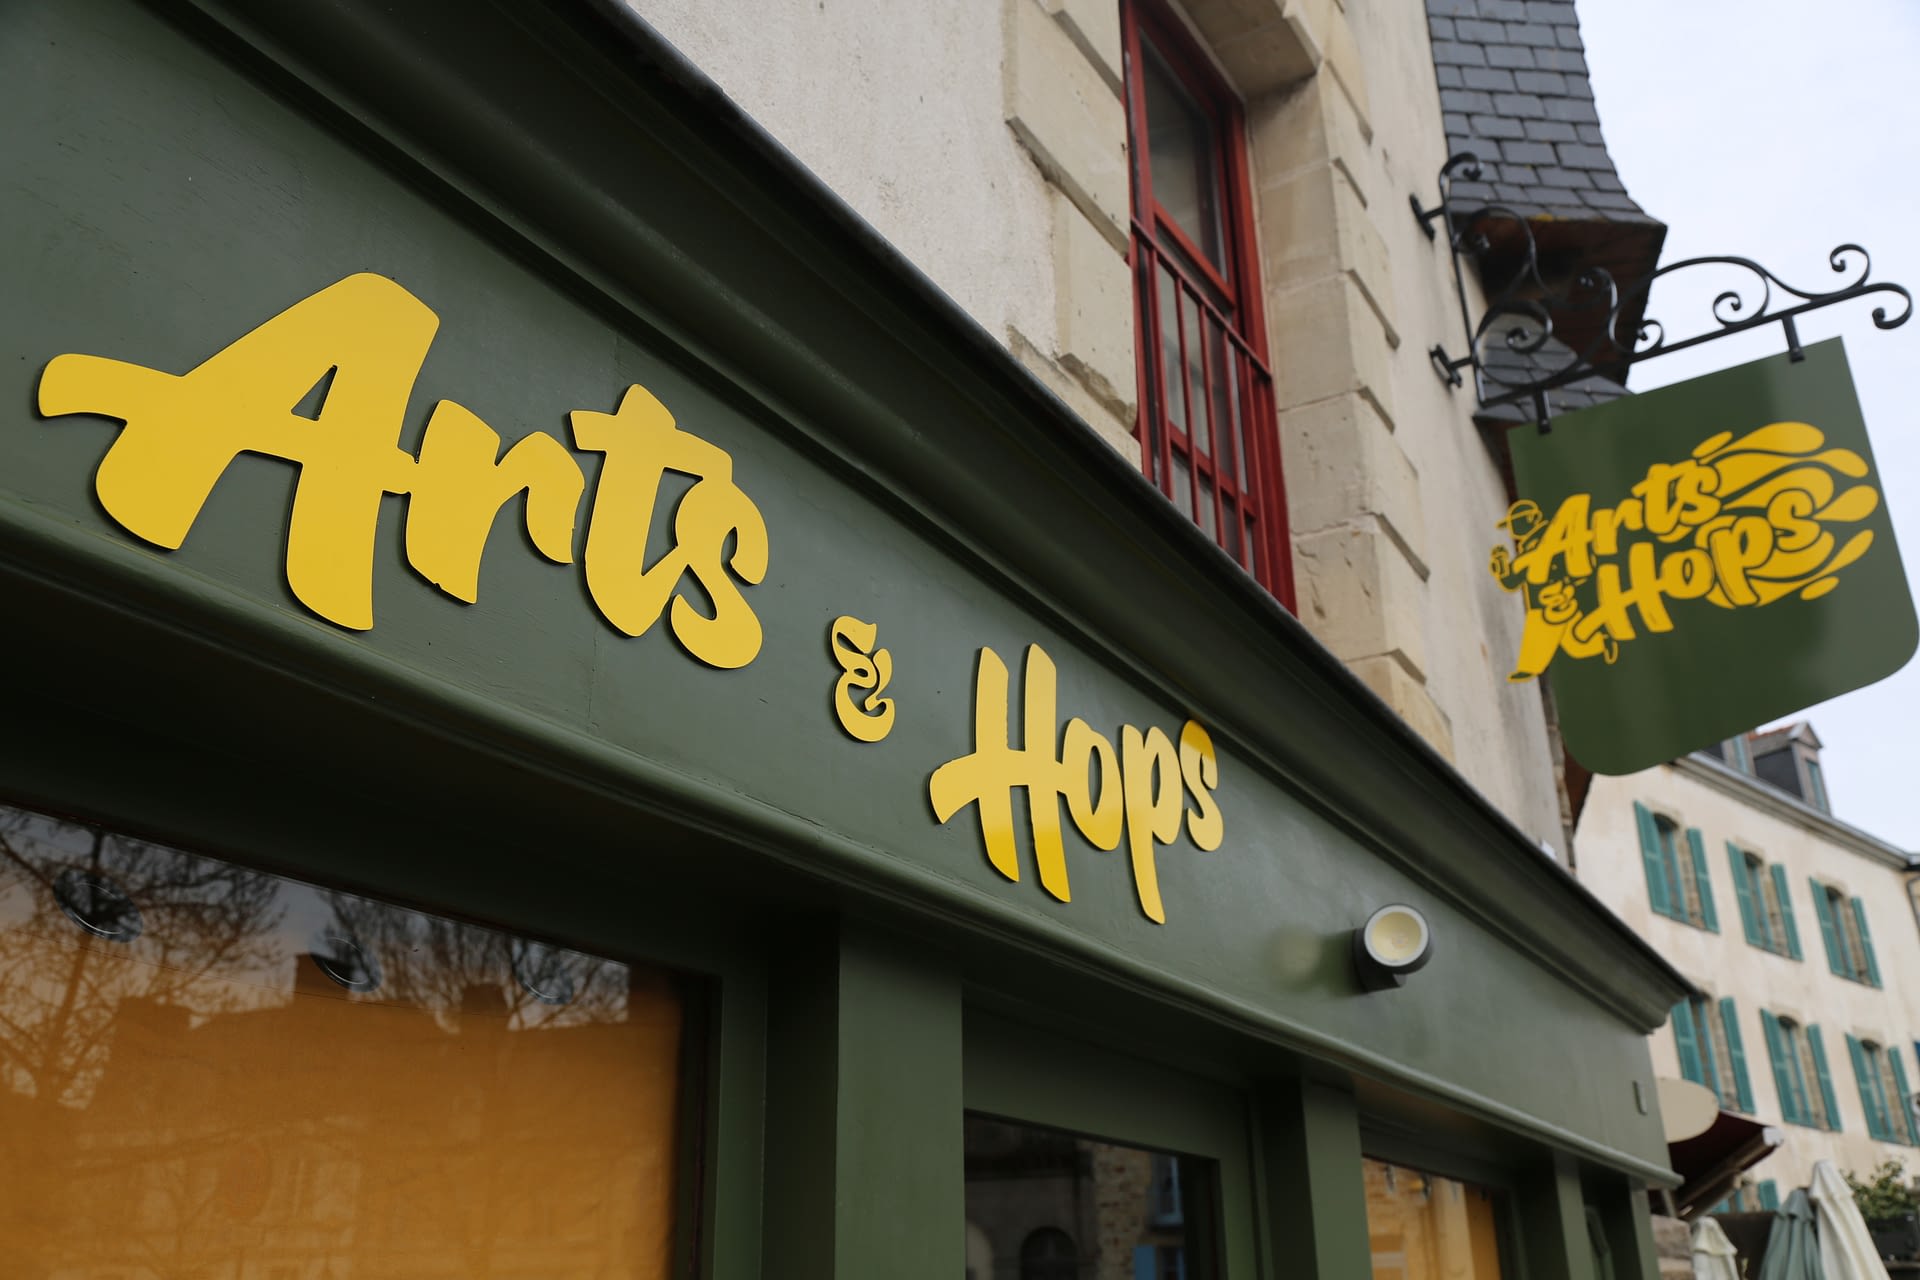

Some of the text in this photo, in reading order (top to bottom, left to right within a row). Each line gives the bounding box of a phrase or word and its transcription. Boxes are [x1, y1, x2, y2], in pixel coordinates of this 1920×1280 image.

[1512, 460, 1721, 584] Arts
[1573, 489, 1821, 641] Hops
[38, 272, 1224, 925] Arts & Hops
